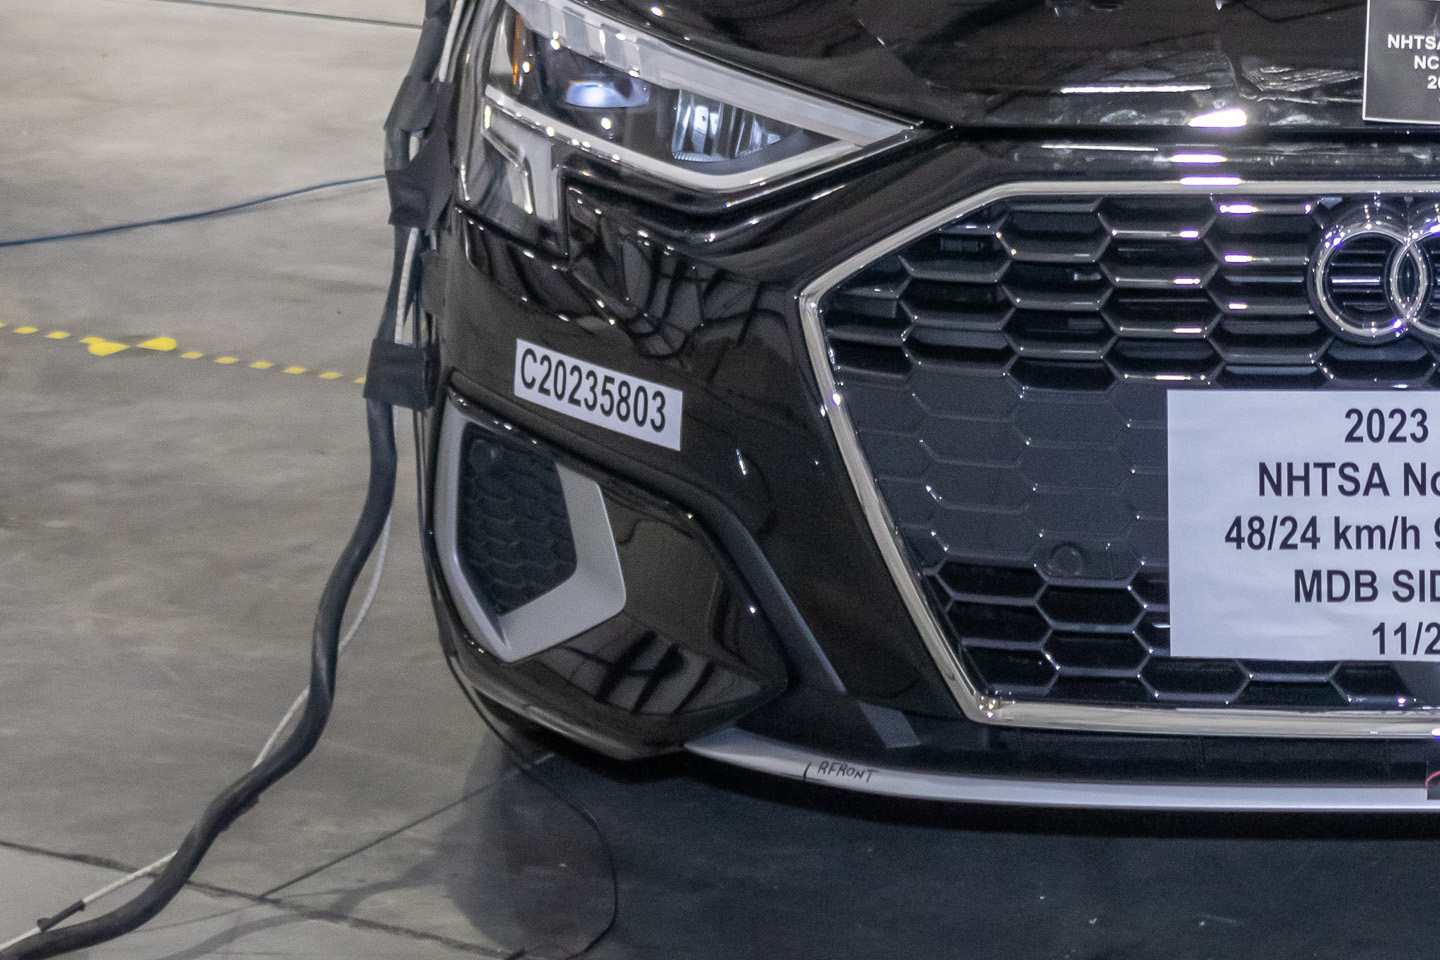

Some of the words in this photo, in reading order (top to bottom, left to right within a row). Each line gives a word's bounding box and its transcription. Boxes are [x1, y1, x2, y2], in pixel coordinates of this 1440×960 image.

[521, 349, 666, 433] C20235803
[1345, 408, 1428, 443] 2023
[1259, 462, 1390, 496] NHTSA
[1225, 516, 1320, 550] 48/24
[1334, 516, 1420, 550] km/h
[1295, 570, 1378, 602] MDB
